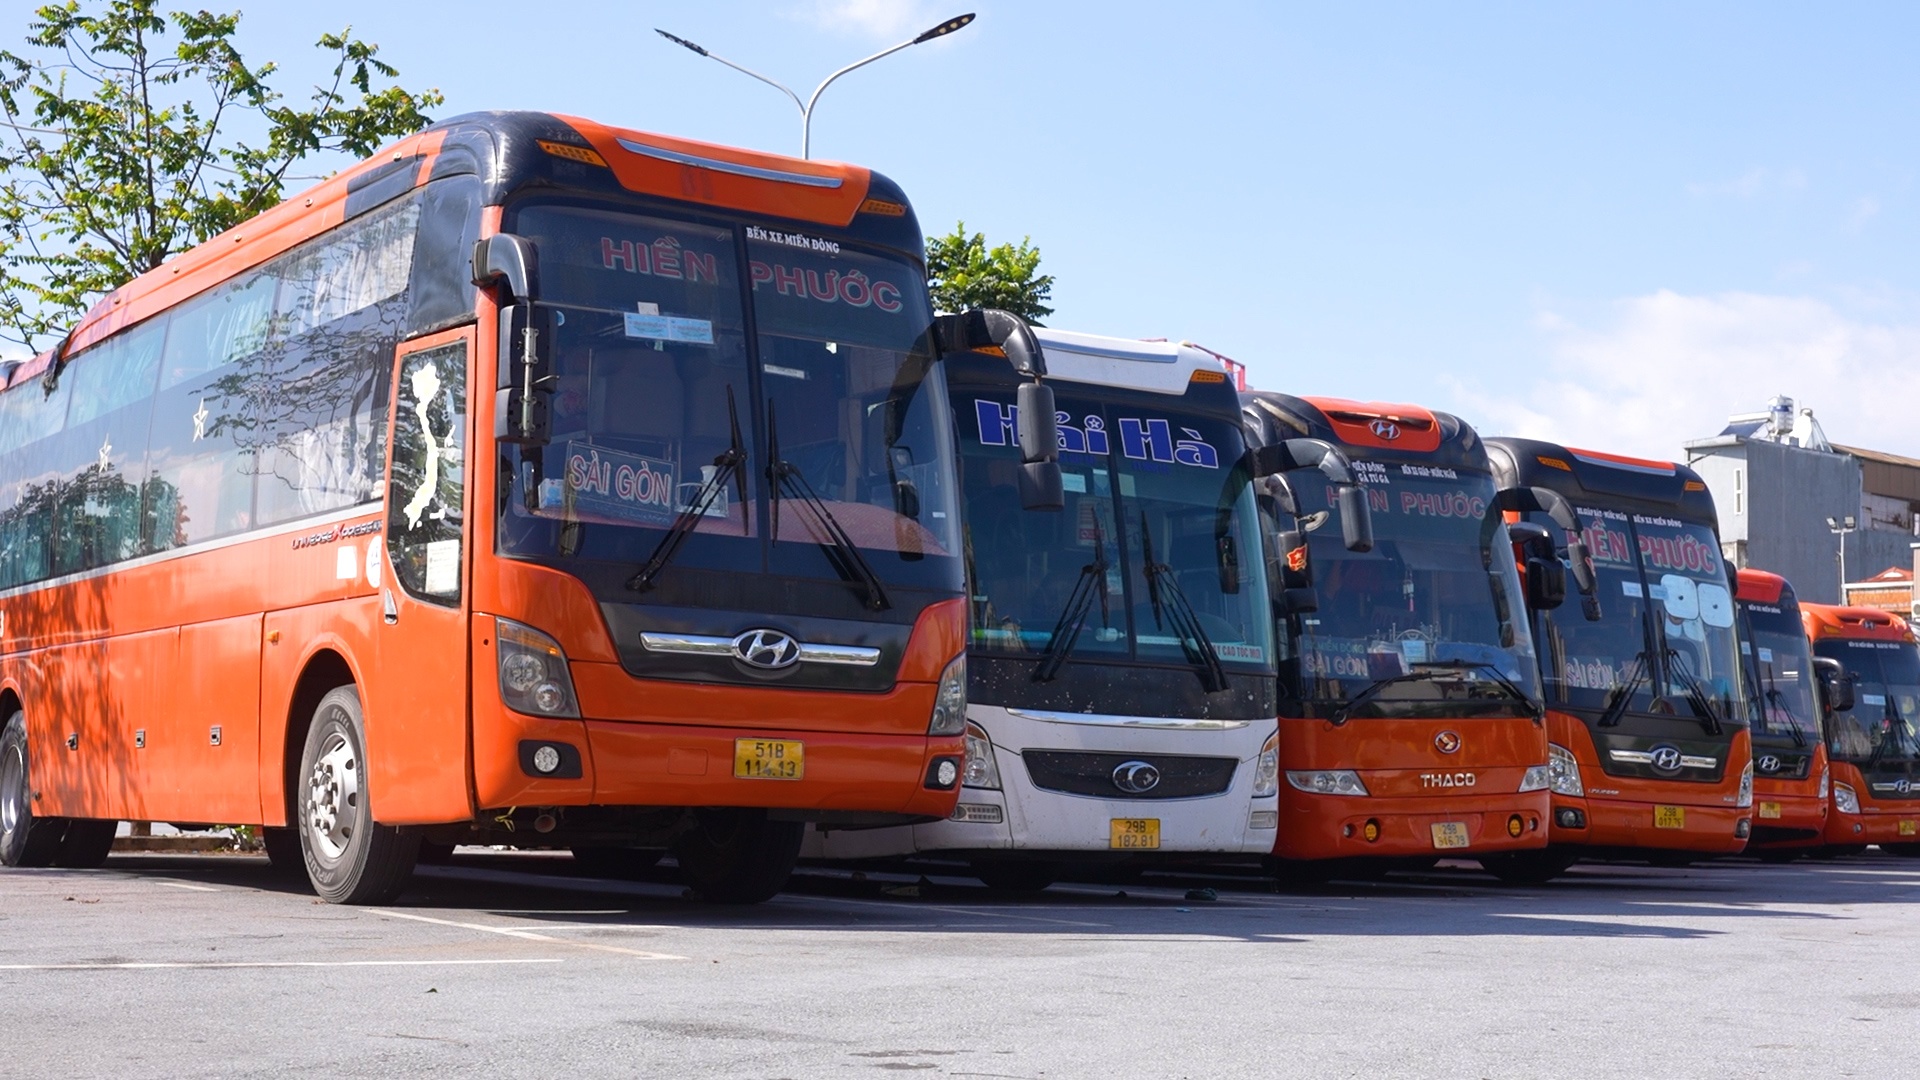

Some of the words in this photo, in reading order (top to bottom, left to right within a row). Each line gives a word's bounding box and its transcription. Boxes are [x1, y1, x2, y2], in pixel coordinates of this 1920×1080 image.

[746, 226, 767, 240] BẾN
[768, 231, 783, 243] XE
[784, 234, 810, 248] MIỀN
[811, 238, 840, 253] ĐÔNG
[601, 236, 718, 283] HIỀN
[750, 260, 903, 313] PHƯỚC
[1118, 418, 1219, 469] Hà
[568, 450, 611, 496] SÀI
[615, 460, 672, 507] GÒN
[1401, 490, 1486, 520] PHƯỚC
[1638, 534, 1717, 575] PHƯỚC
[1333, 653, 1368, 677] GÒN
[1565, 657, 1588, 688] SÀI
[755, 742, 784, 758] 51B
[1420, 773, 1476, 788] THACO
[1118, 835, 1154, 847] 182.81
[1125, 821, 1146, 833] 29B
